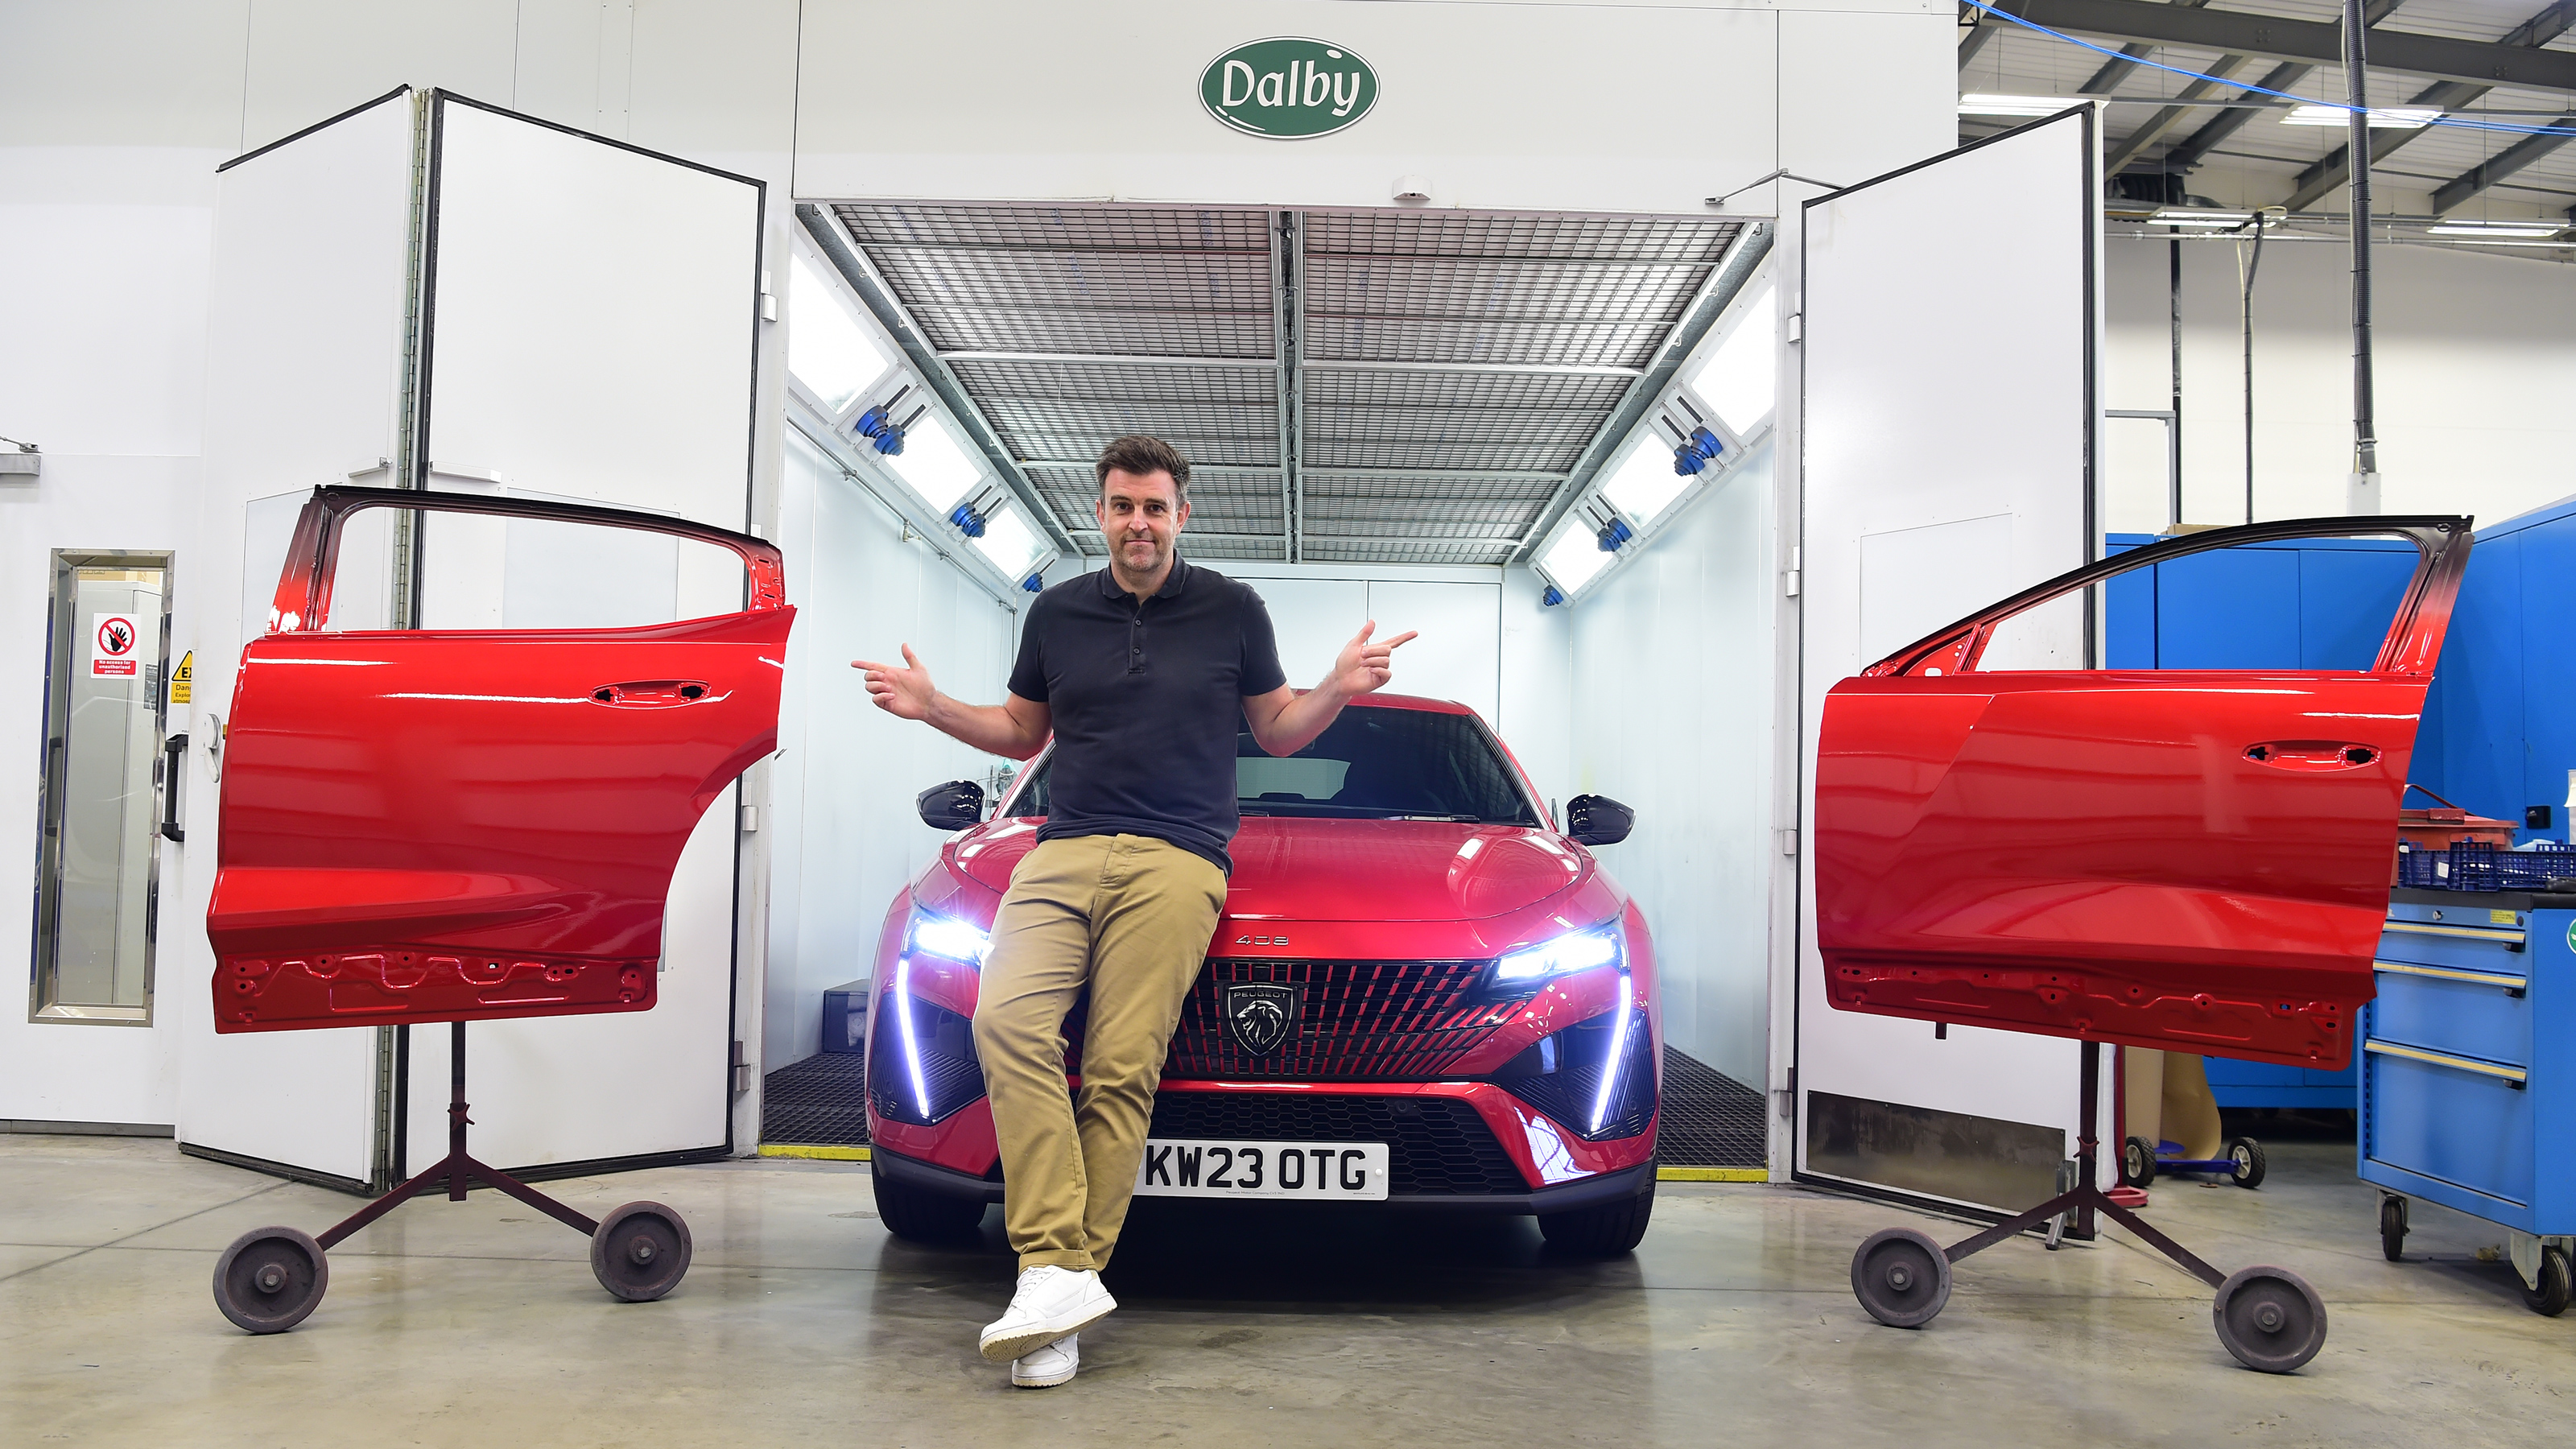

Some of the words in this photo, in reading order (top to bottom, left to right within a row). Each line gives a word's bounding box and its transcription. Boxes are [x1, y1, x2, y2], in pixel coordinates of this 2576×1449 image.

[1222, 59, 1360, 117] Dalby
[1235, 935, 1289, 946] 408
[1146, 1146, 1263, 1189] KW23
[1279, 1149, 1366, 1190] OTG
